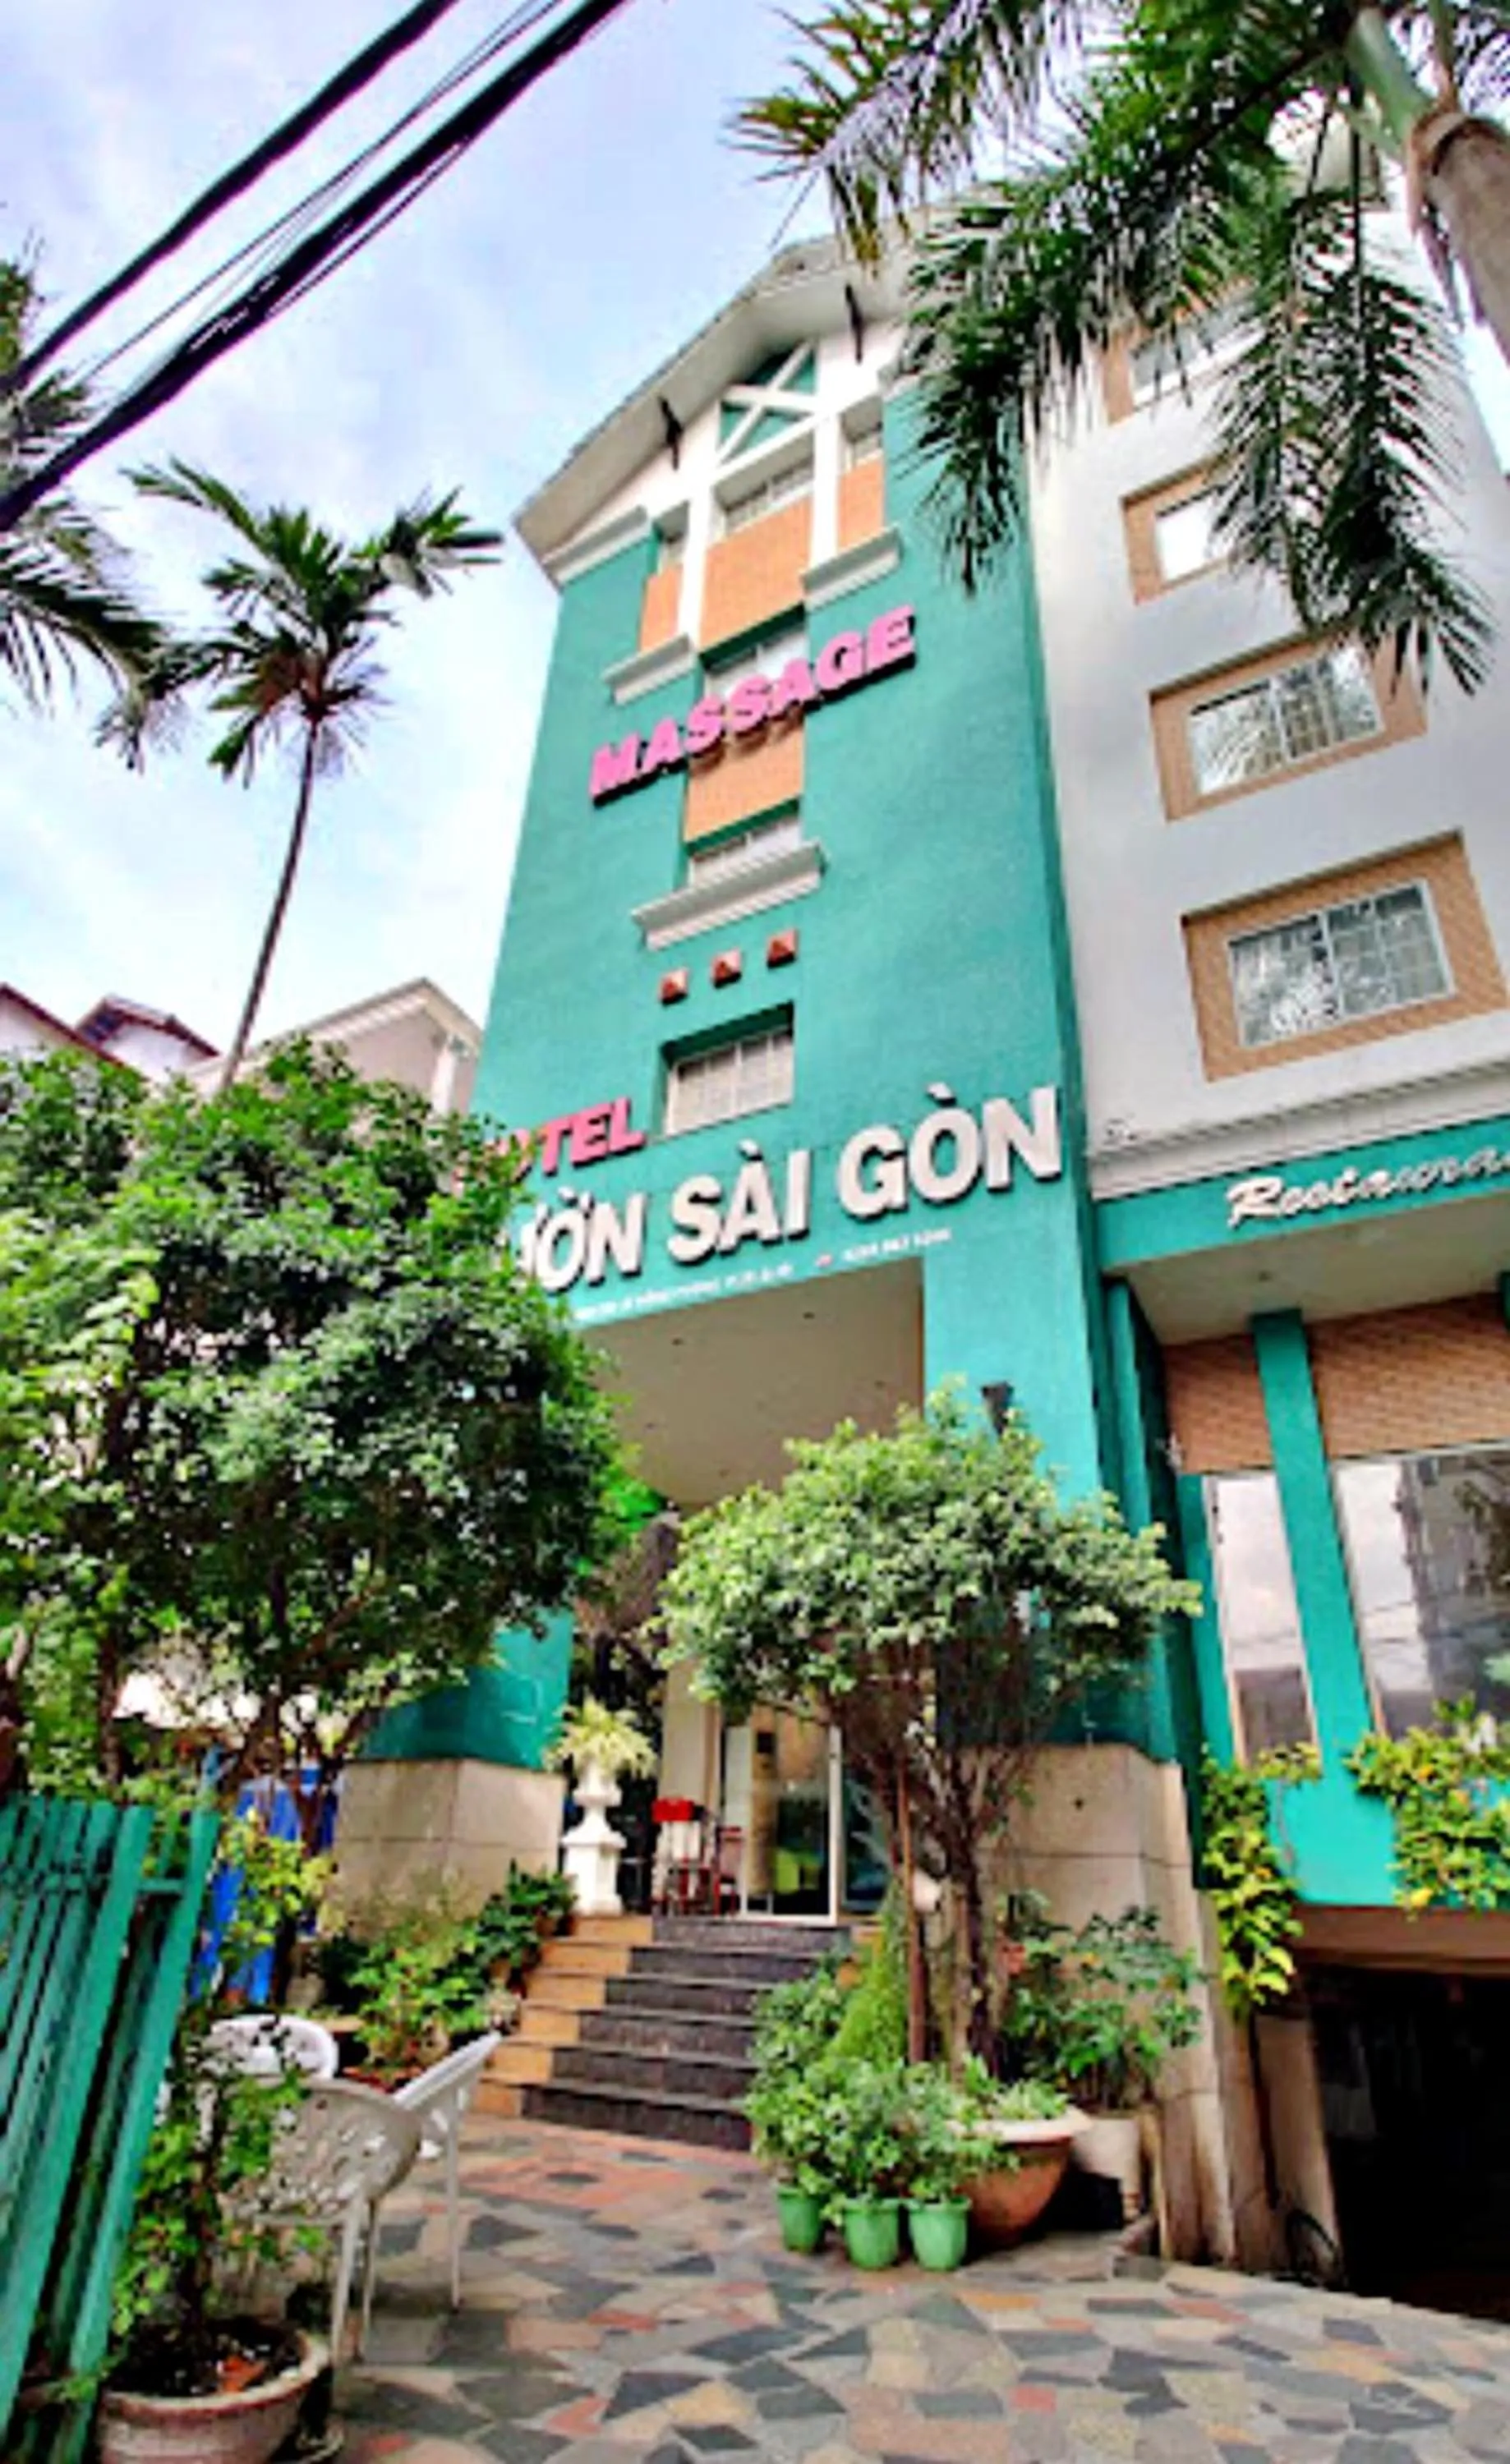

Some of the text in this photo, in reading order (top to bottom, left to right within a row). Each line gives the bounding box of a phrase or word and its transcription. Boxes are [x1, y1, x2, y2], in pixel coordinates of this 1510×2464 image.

[589, 605, 915, 807] MASSAGE
[457, 1097, 646, 1193] TEL
[667, 1139, 810, 1263] SÀI
[838, 1082, 1063, 1221] GÒN
